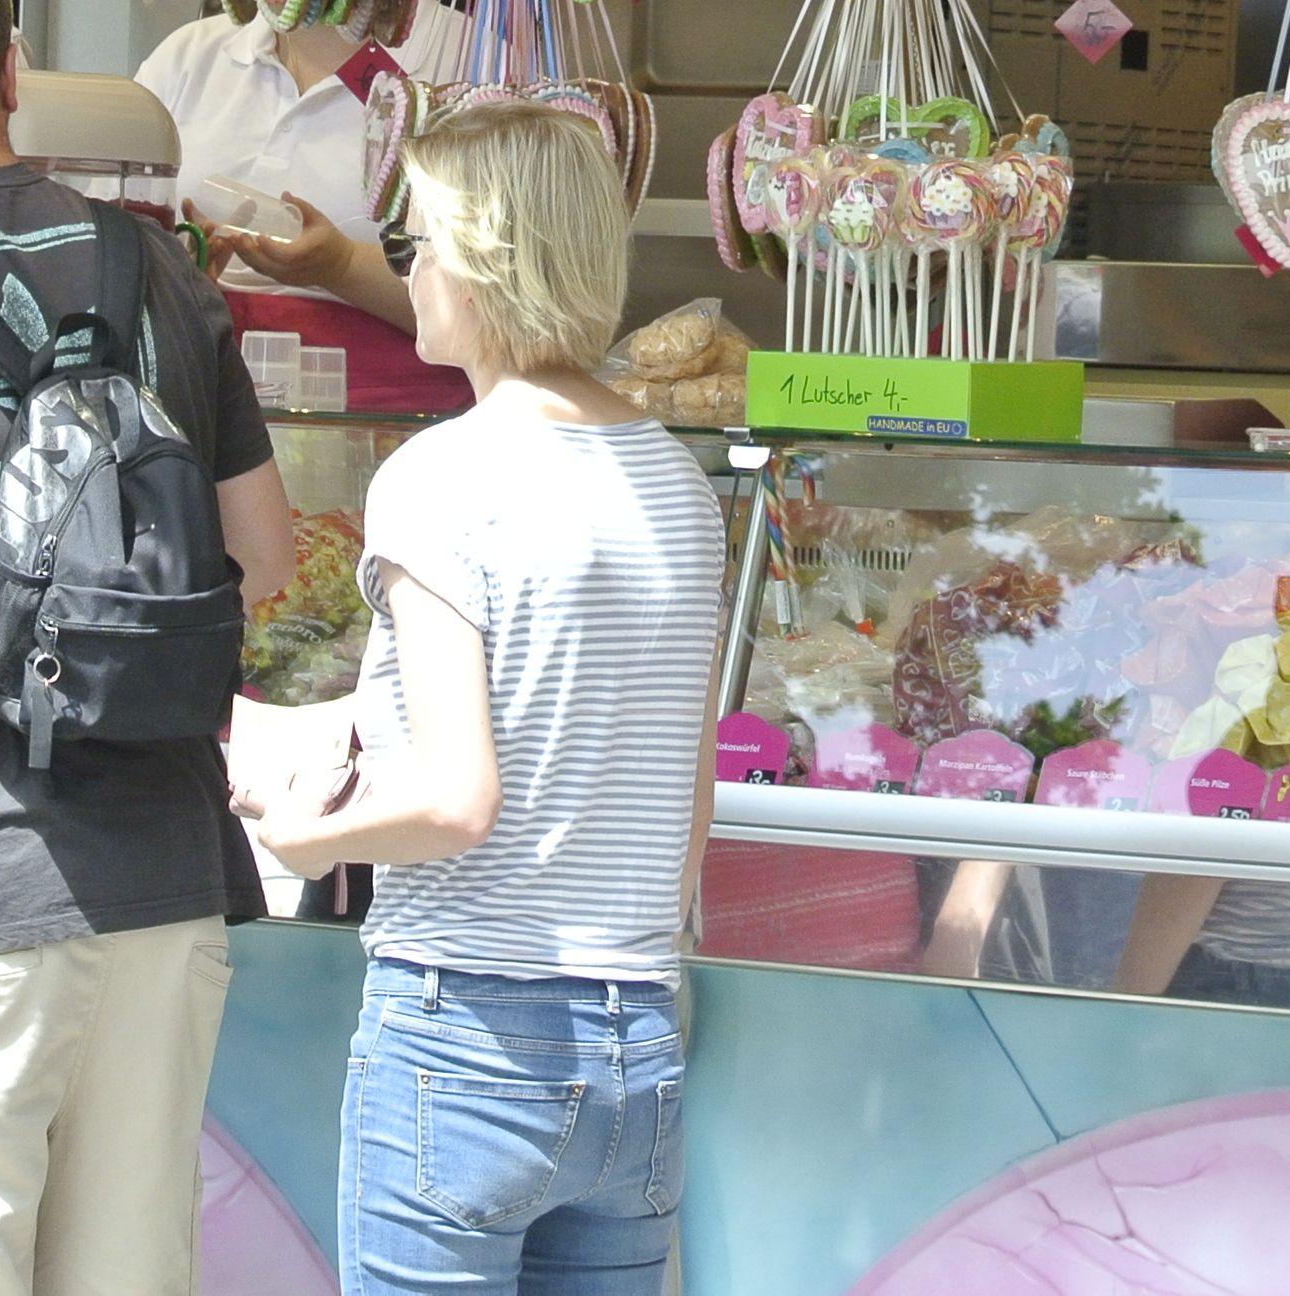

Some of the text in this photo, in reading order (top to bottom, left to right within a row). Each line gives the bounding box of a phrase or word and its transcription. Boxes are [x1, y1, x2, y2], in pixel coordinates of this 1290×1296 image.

[801, 374, 908, 412] Lutscher 4,-
[868, 419, 950, 434] HANDMADE in EU
